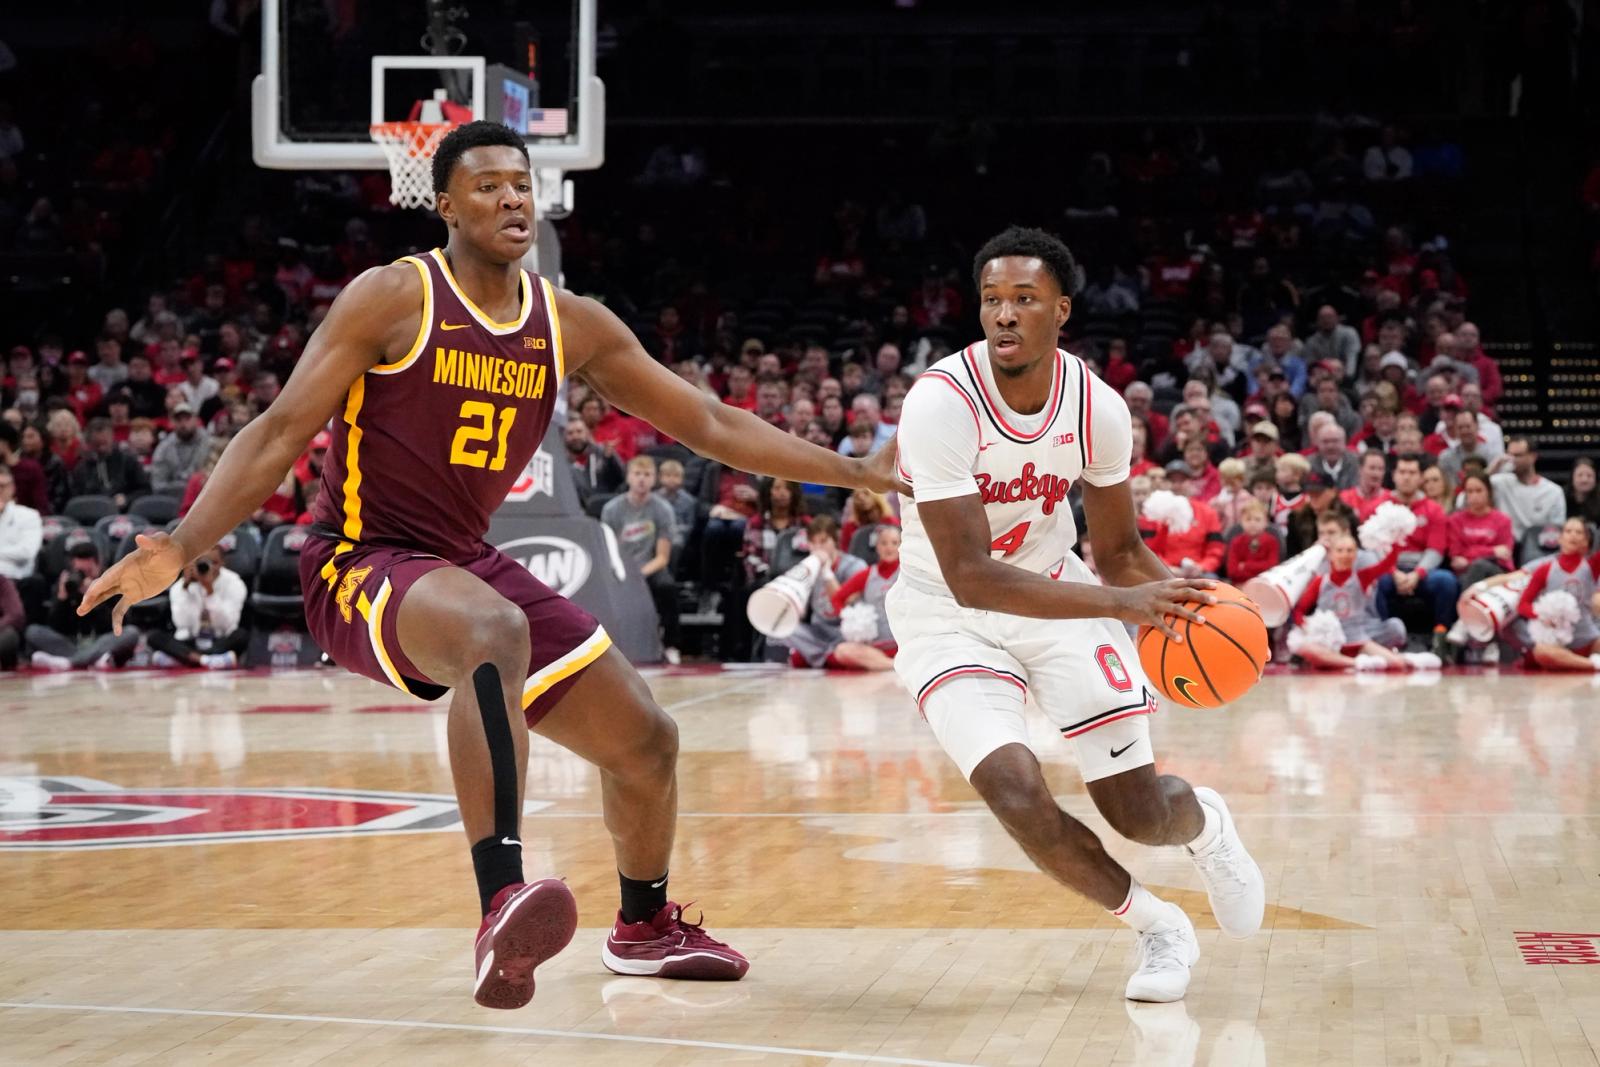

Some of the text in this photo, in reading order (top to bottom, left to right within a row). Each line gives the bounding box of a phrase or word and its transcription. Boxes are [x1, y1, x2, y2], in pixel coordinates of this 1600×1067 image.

[433, 348, 547, 399] MINNESOTA
[450, 400, 517, 471] 21
[991, 521, 1032, 557] 4
